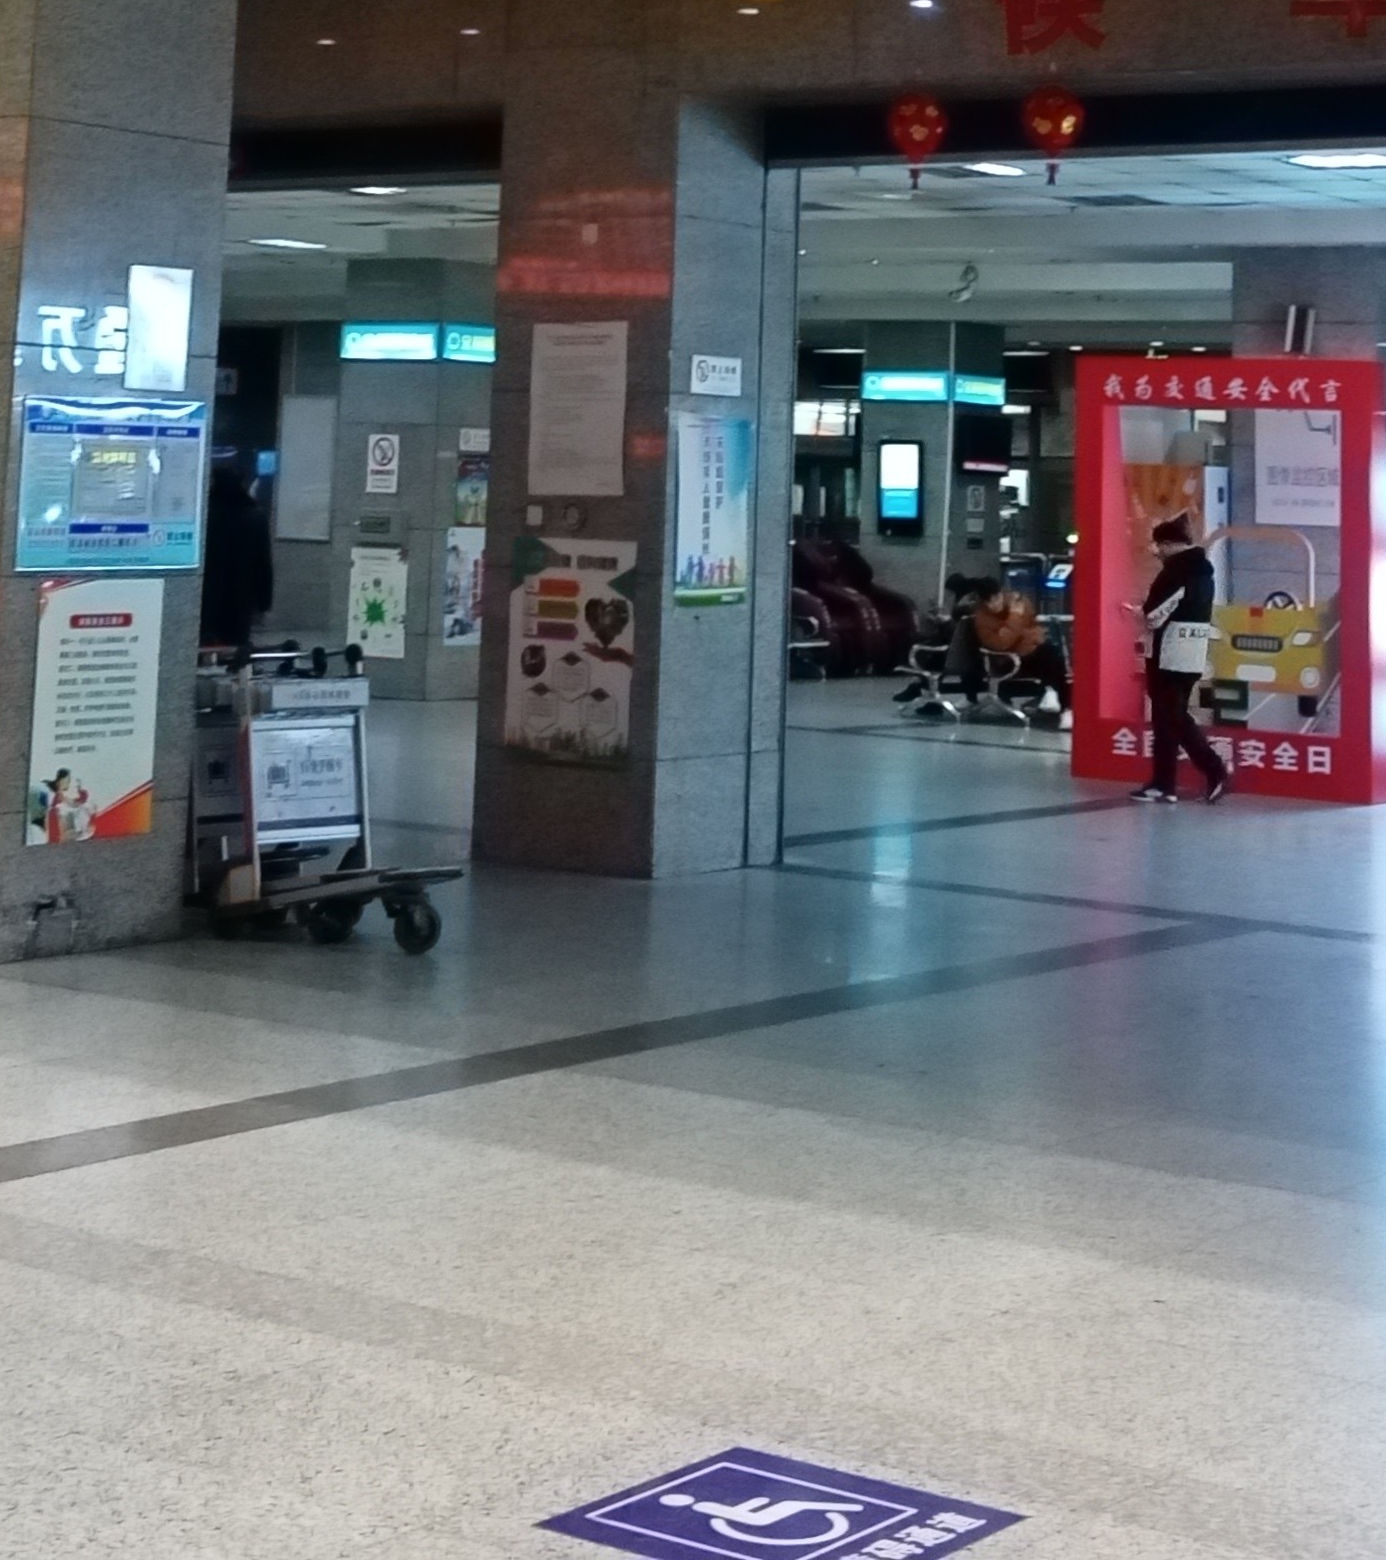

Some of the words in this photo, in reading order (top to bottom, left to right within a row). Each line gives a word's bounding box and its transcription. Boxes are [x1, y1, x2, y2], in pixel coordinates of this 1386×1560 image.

[1103, 373, 1342, 404] 我为交通安全代言
[1111, 726, 1332, 776] 全通安全日
